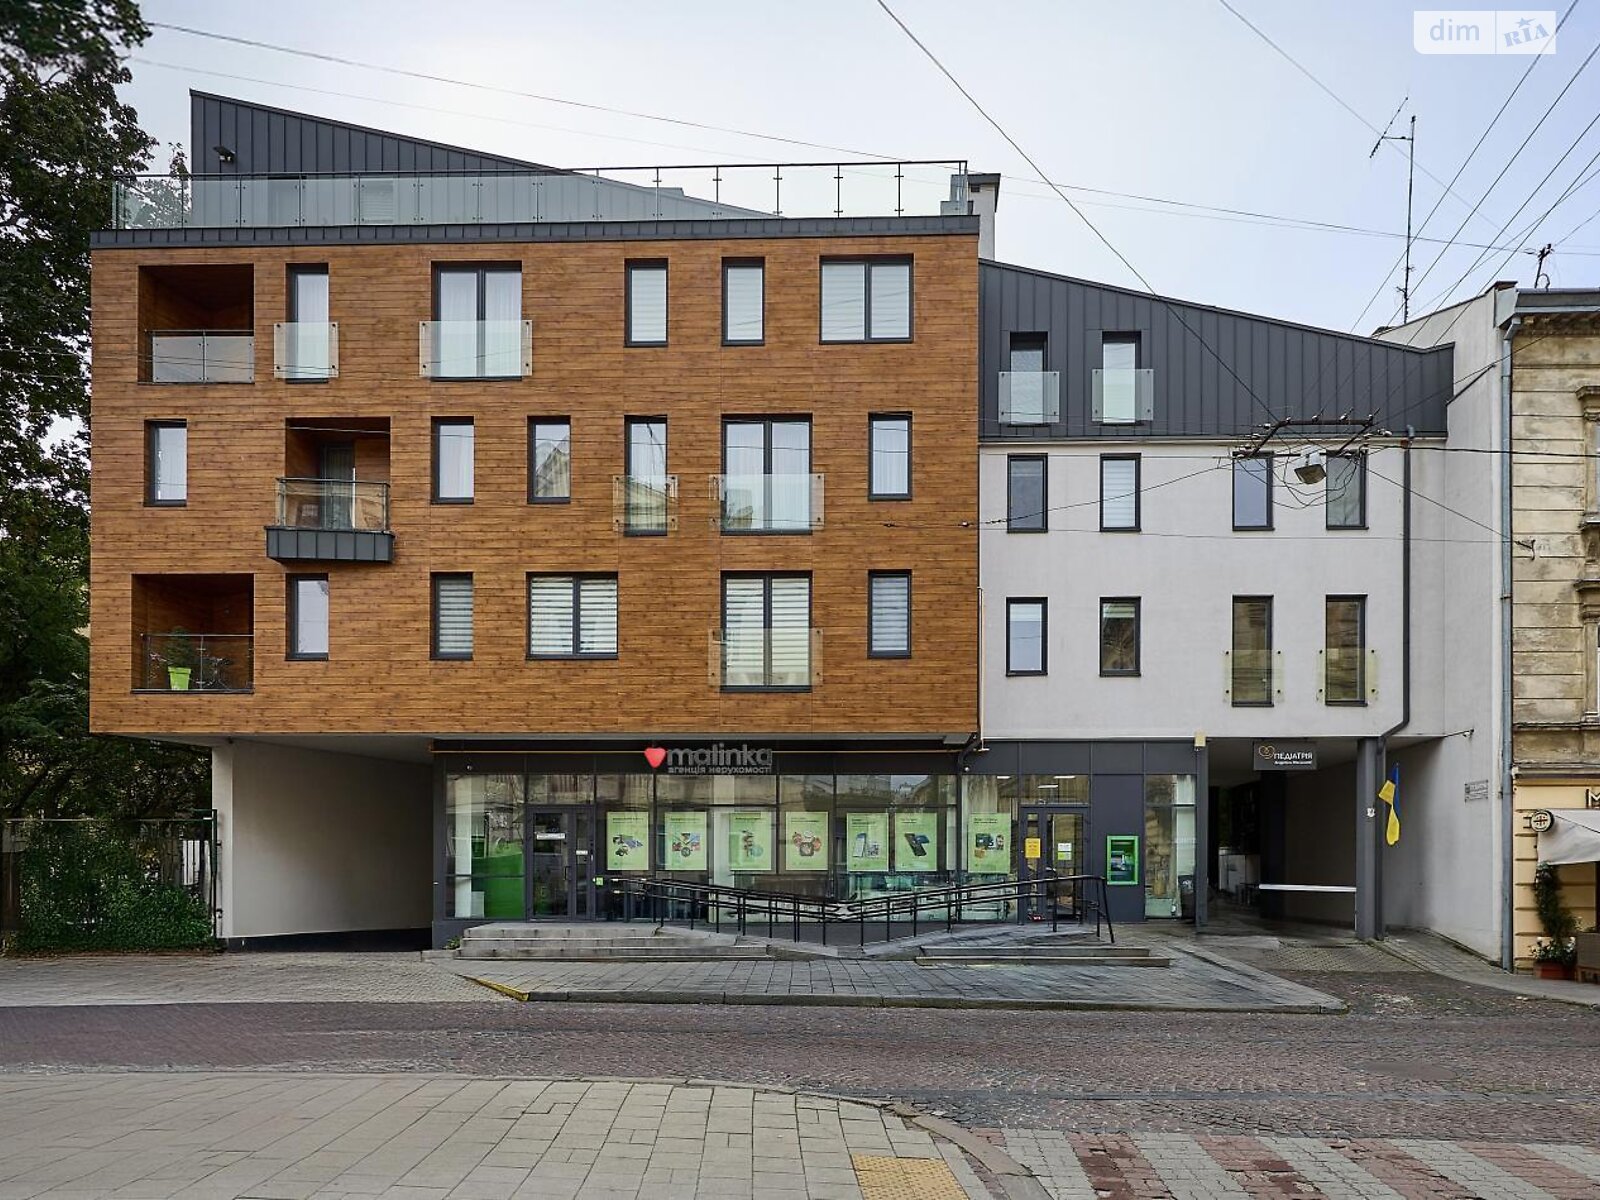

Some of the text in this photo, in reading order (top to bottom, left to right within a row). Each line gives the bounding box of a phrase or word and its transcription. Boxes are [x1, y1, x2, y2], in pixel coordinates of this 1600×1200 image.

[667, 743, 773, 766] malinka
[667, 765, 772, 775] агенція нерухомості
